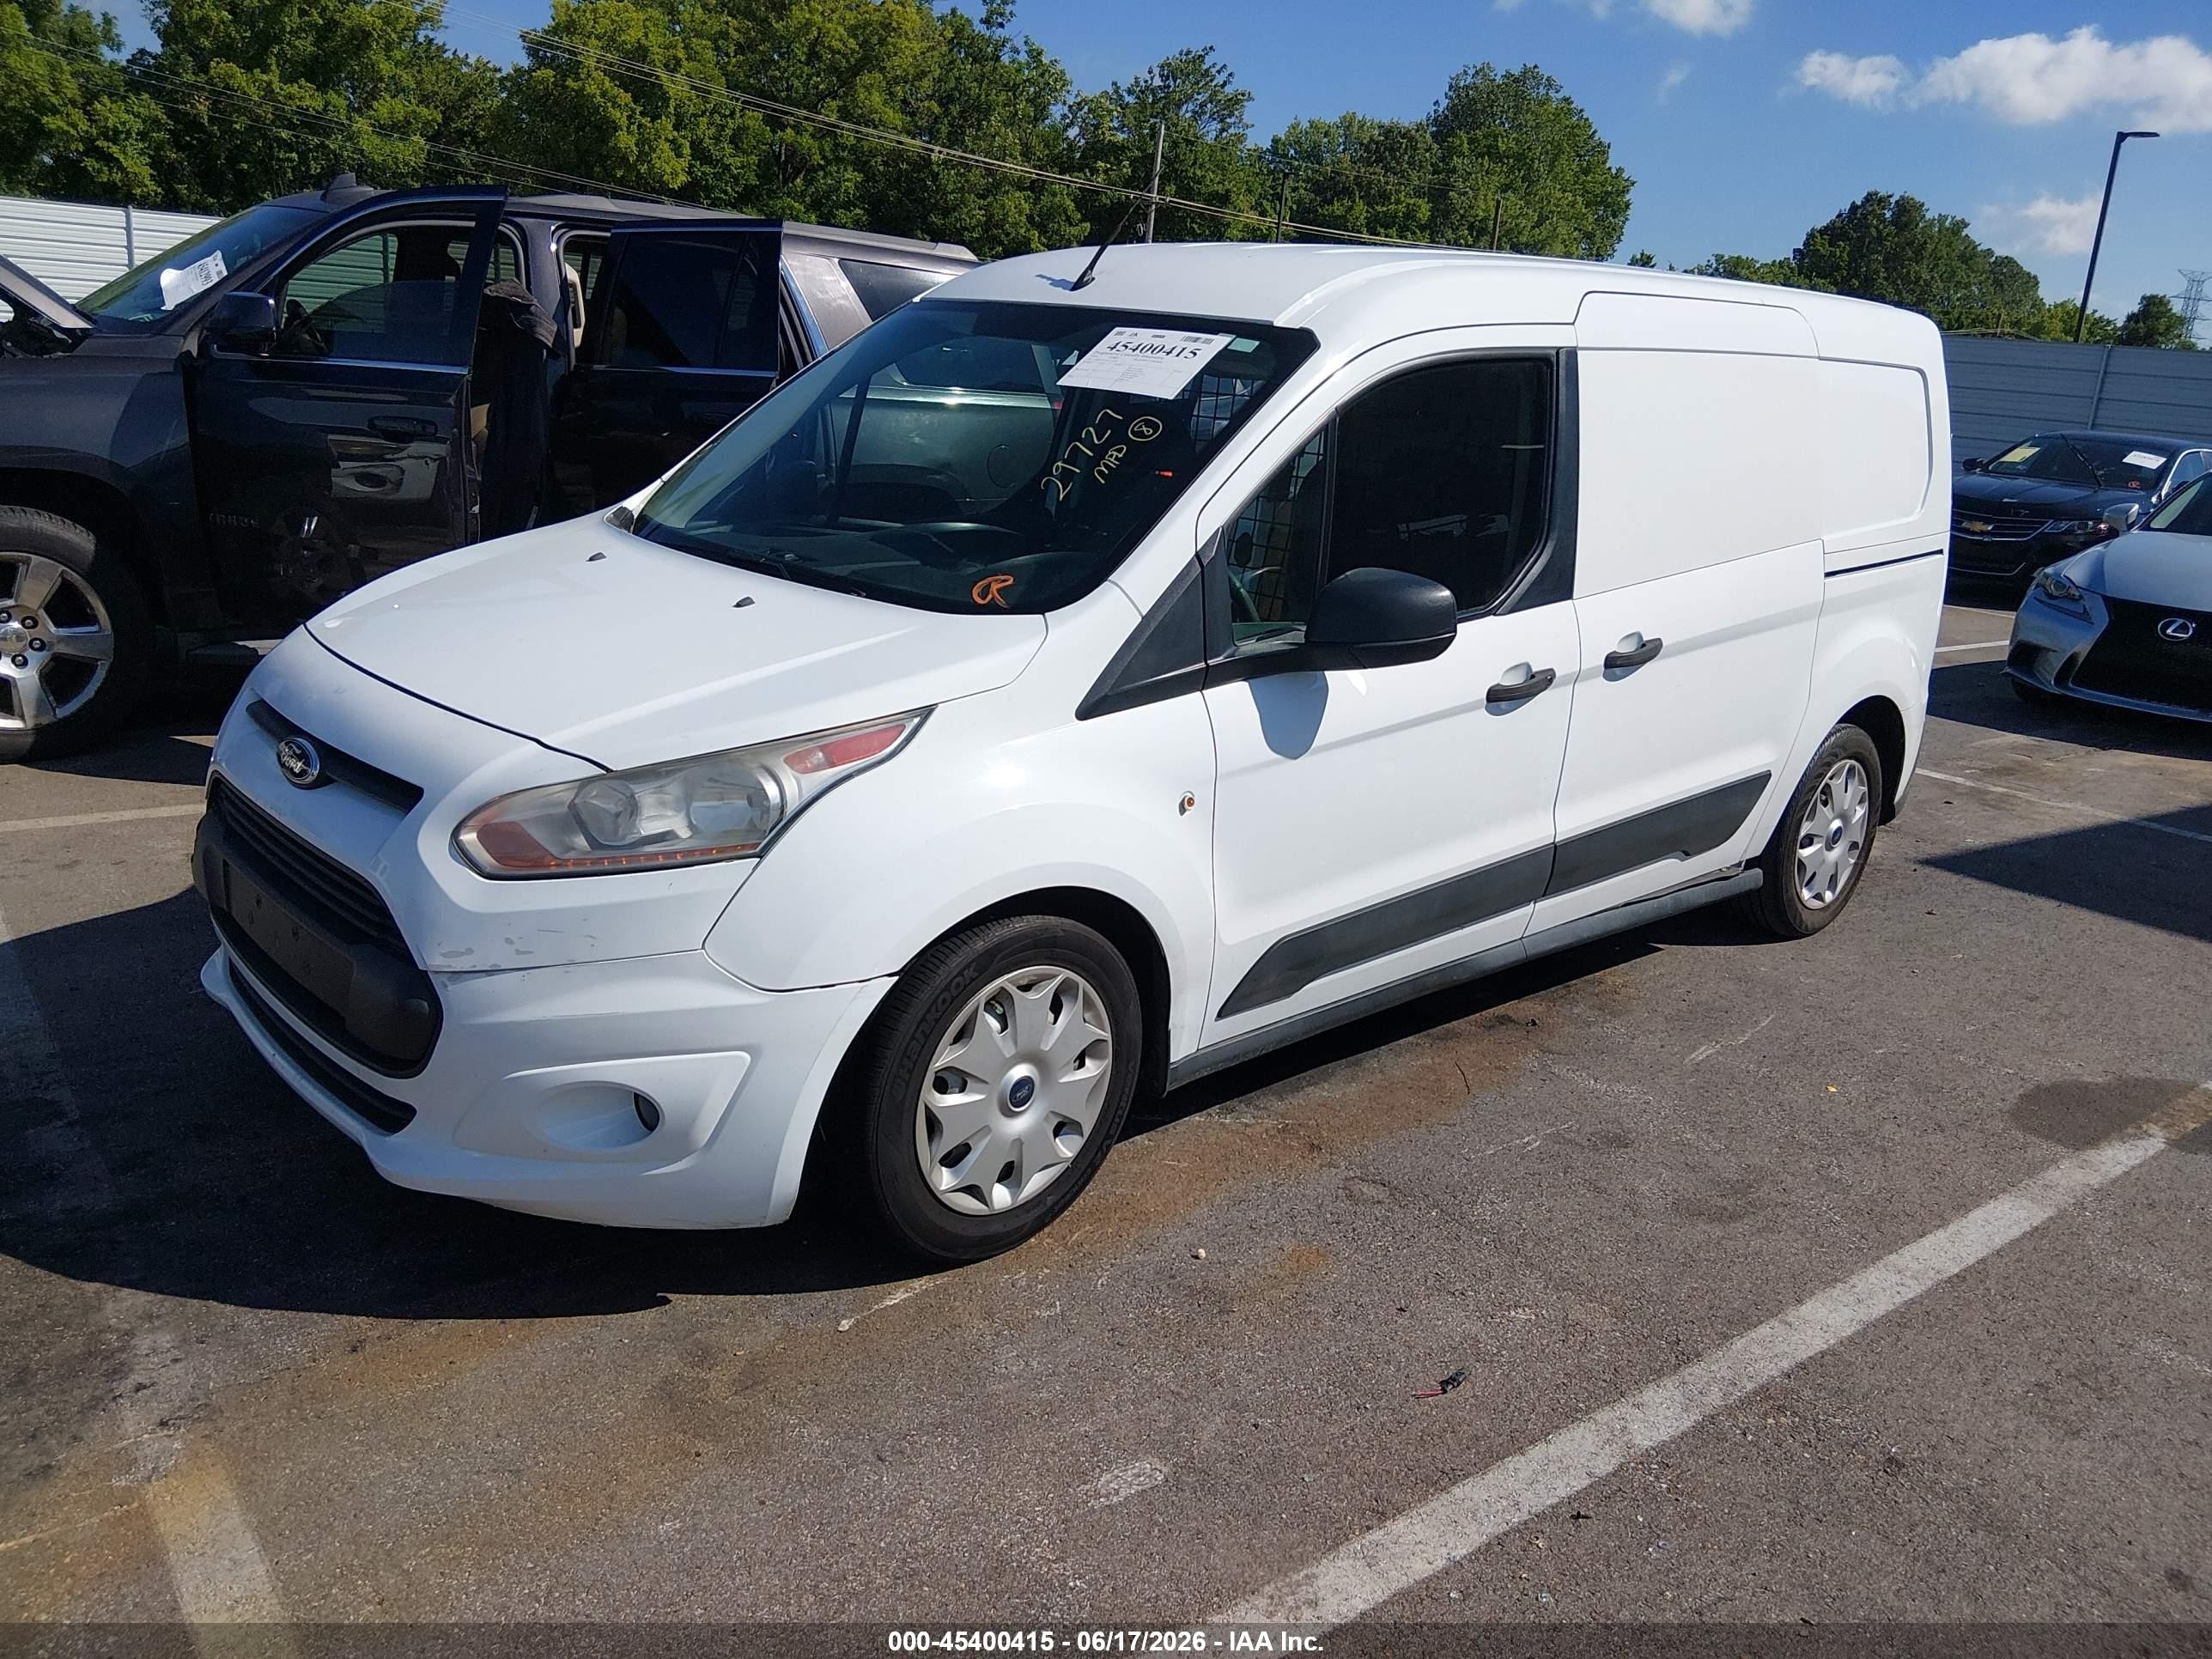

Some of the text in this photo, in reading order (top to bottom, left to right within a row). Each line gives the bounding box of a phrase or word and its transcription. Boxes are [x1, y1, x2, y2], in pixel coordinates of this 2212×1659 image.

[1106, 339, 1202, 360] 45400415
[1041, 408, 1124, 501] 29727
[279, 743, 309, 774] Ford
